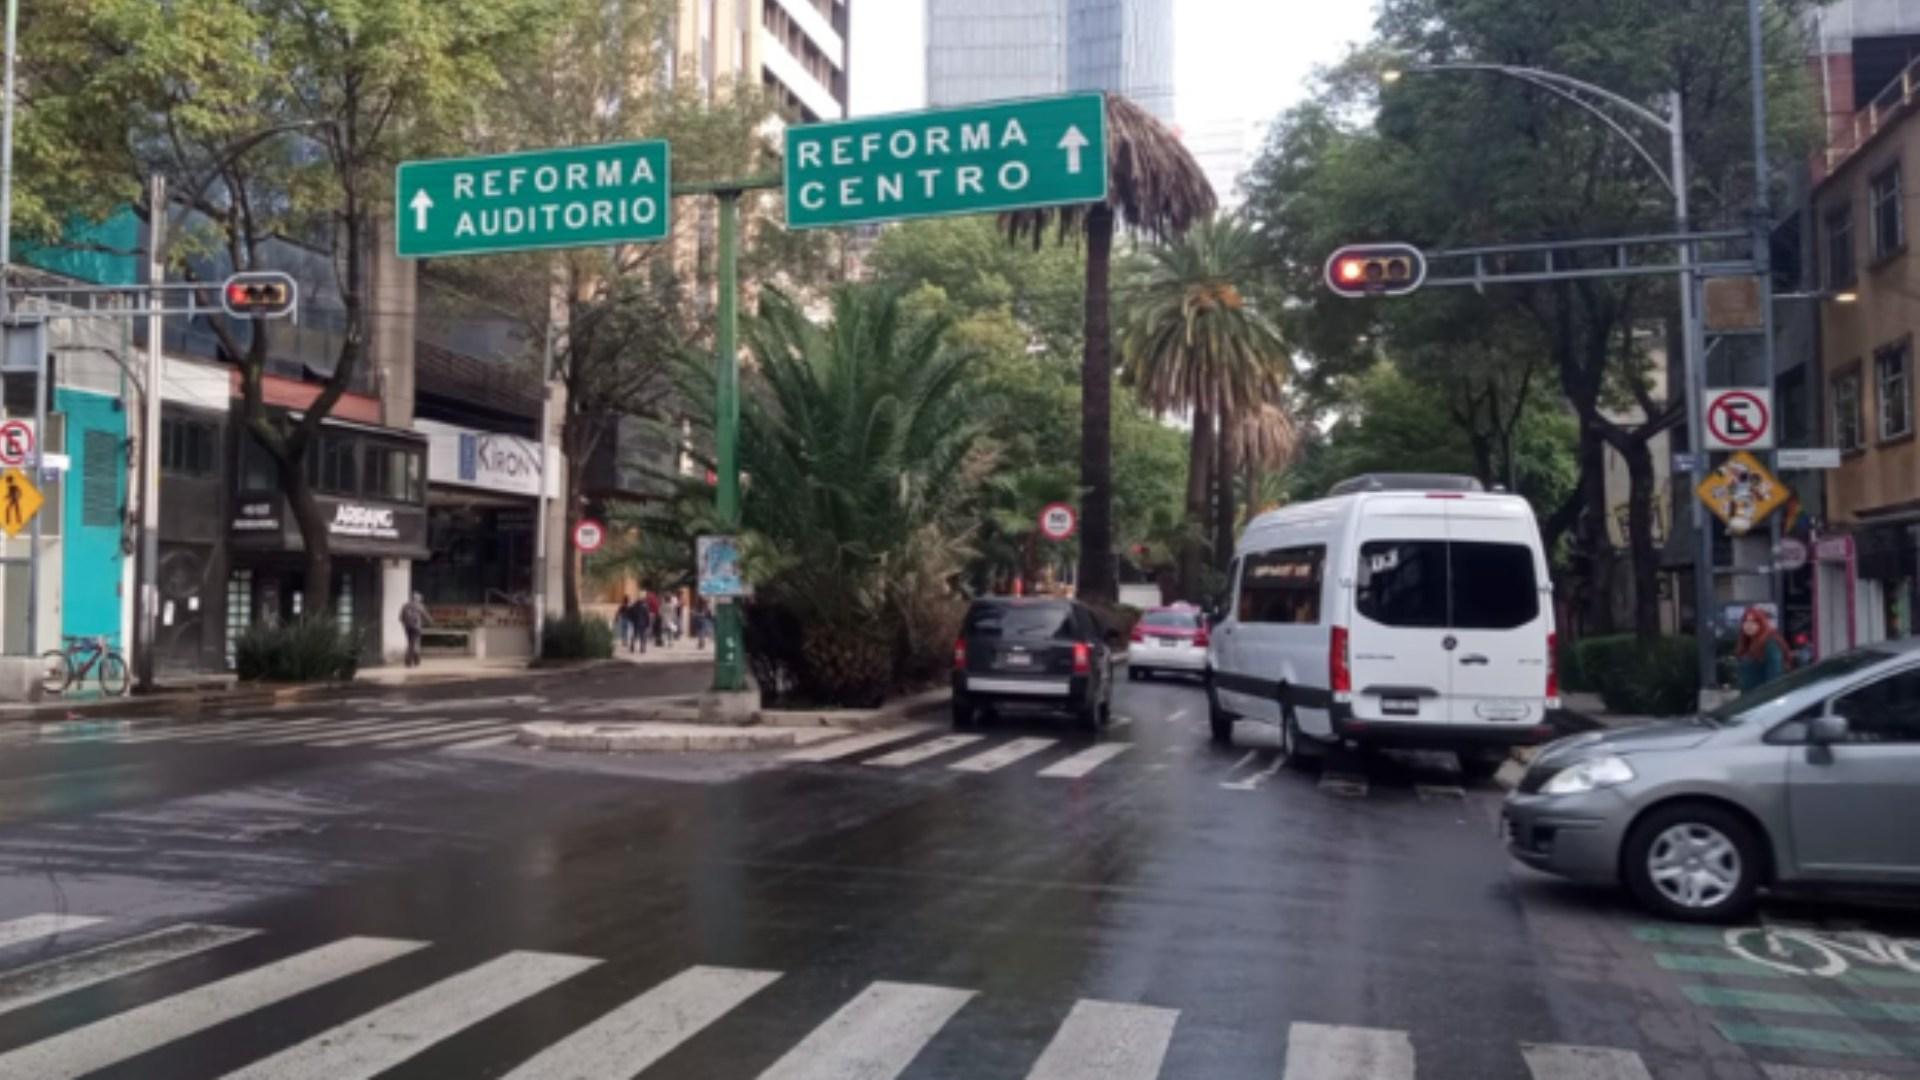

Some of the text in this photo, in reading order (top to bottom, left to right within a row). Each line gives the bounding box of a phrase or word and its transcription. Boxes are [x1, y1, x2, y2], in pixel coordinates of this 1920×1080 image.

[798, 118, 1027, 168] REFORMA
[454, 157, 655, 200] REFORMA
[799, 161, 1030, 209] CENTRO
[454, 197, 656, 237] AUDITORIO
[1726, 402, 1751, 434] E
